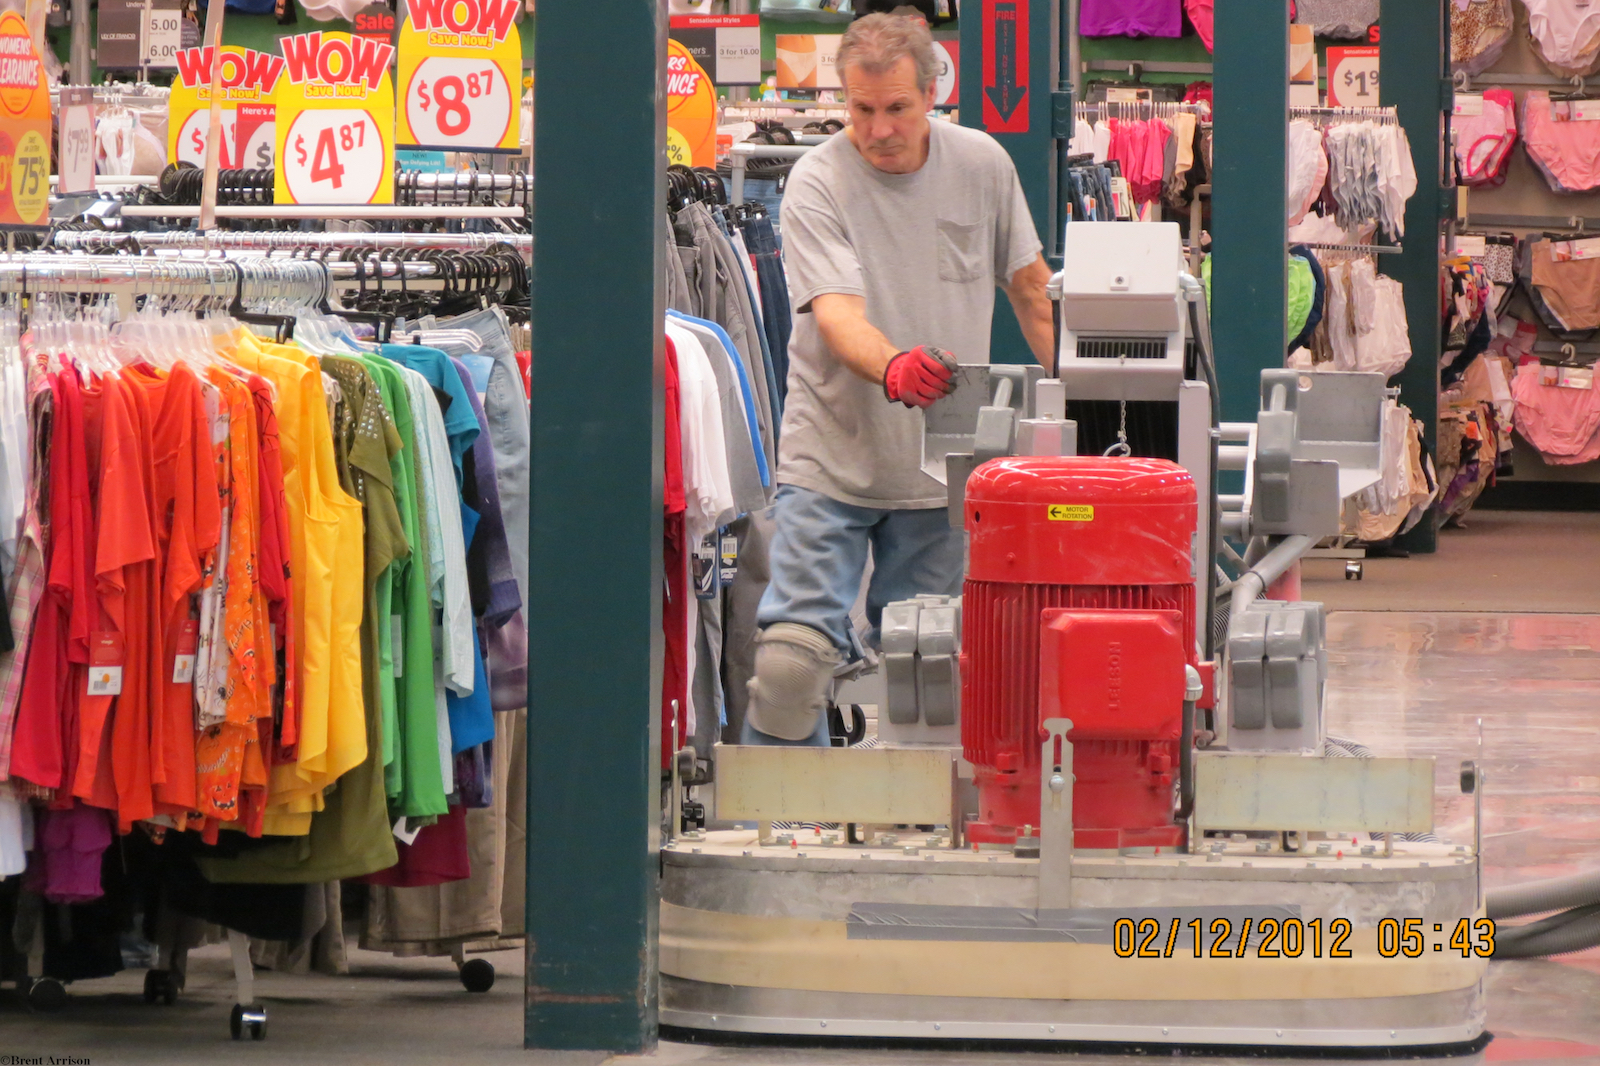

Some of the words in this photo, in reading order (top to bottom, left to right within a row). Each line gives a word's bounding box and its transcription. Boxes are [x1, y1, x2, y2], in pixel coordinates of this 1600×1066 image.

[355, 13, 394, 30] Sale
[406, 0, 521, 42] WOW
[996, 11, 1015, 20] FIRE
[151, 19, 178, 31] 5.00
[430, 32, 459, 45] Save
[461, 29, 495, 48] Now!
[150, 45, 177, 57] 6.00
[687, 47, 707, 55] ners
[726, 48, 737, 56] for
[740, 48, 760, 56] 18.00
[280, 30, 395, 92] WOW
[668, 56, 687, 71] RS
[175, 45, 285, 95] WOW
[199, 88, 228, 99] Sae
[229, 84, 261, 100] Now!
[306, 83, 333, 97] Save
[335, 78, 368, 98] Now!
[667, 74, 700, 94] NCE
[242, 107, 267, 115] Here's
[18, 156, 46, 195] 75%
